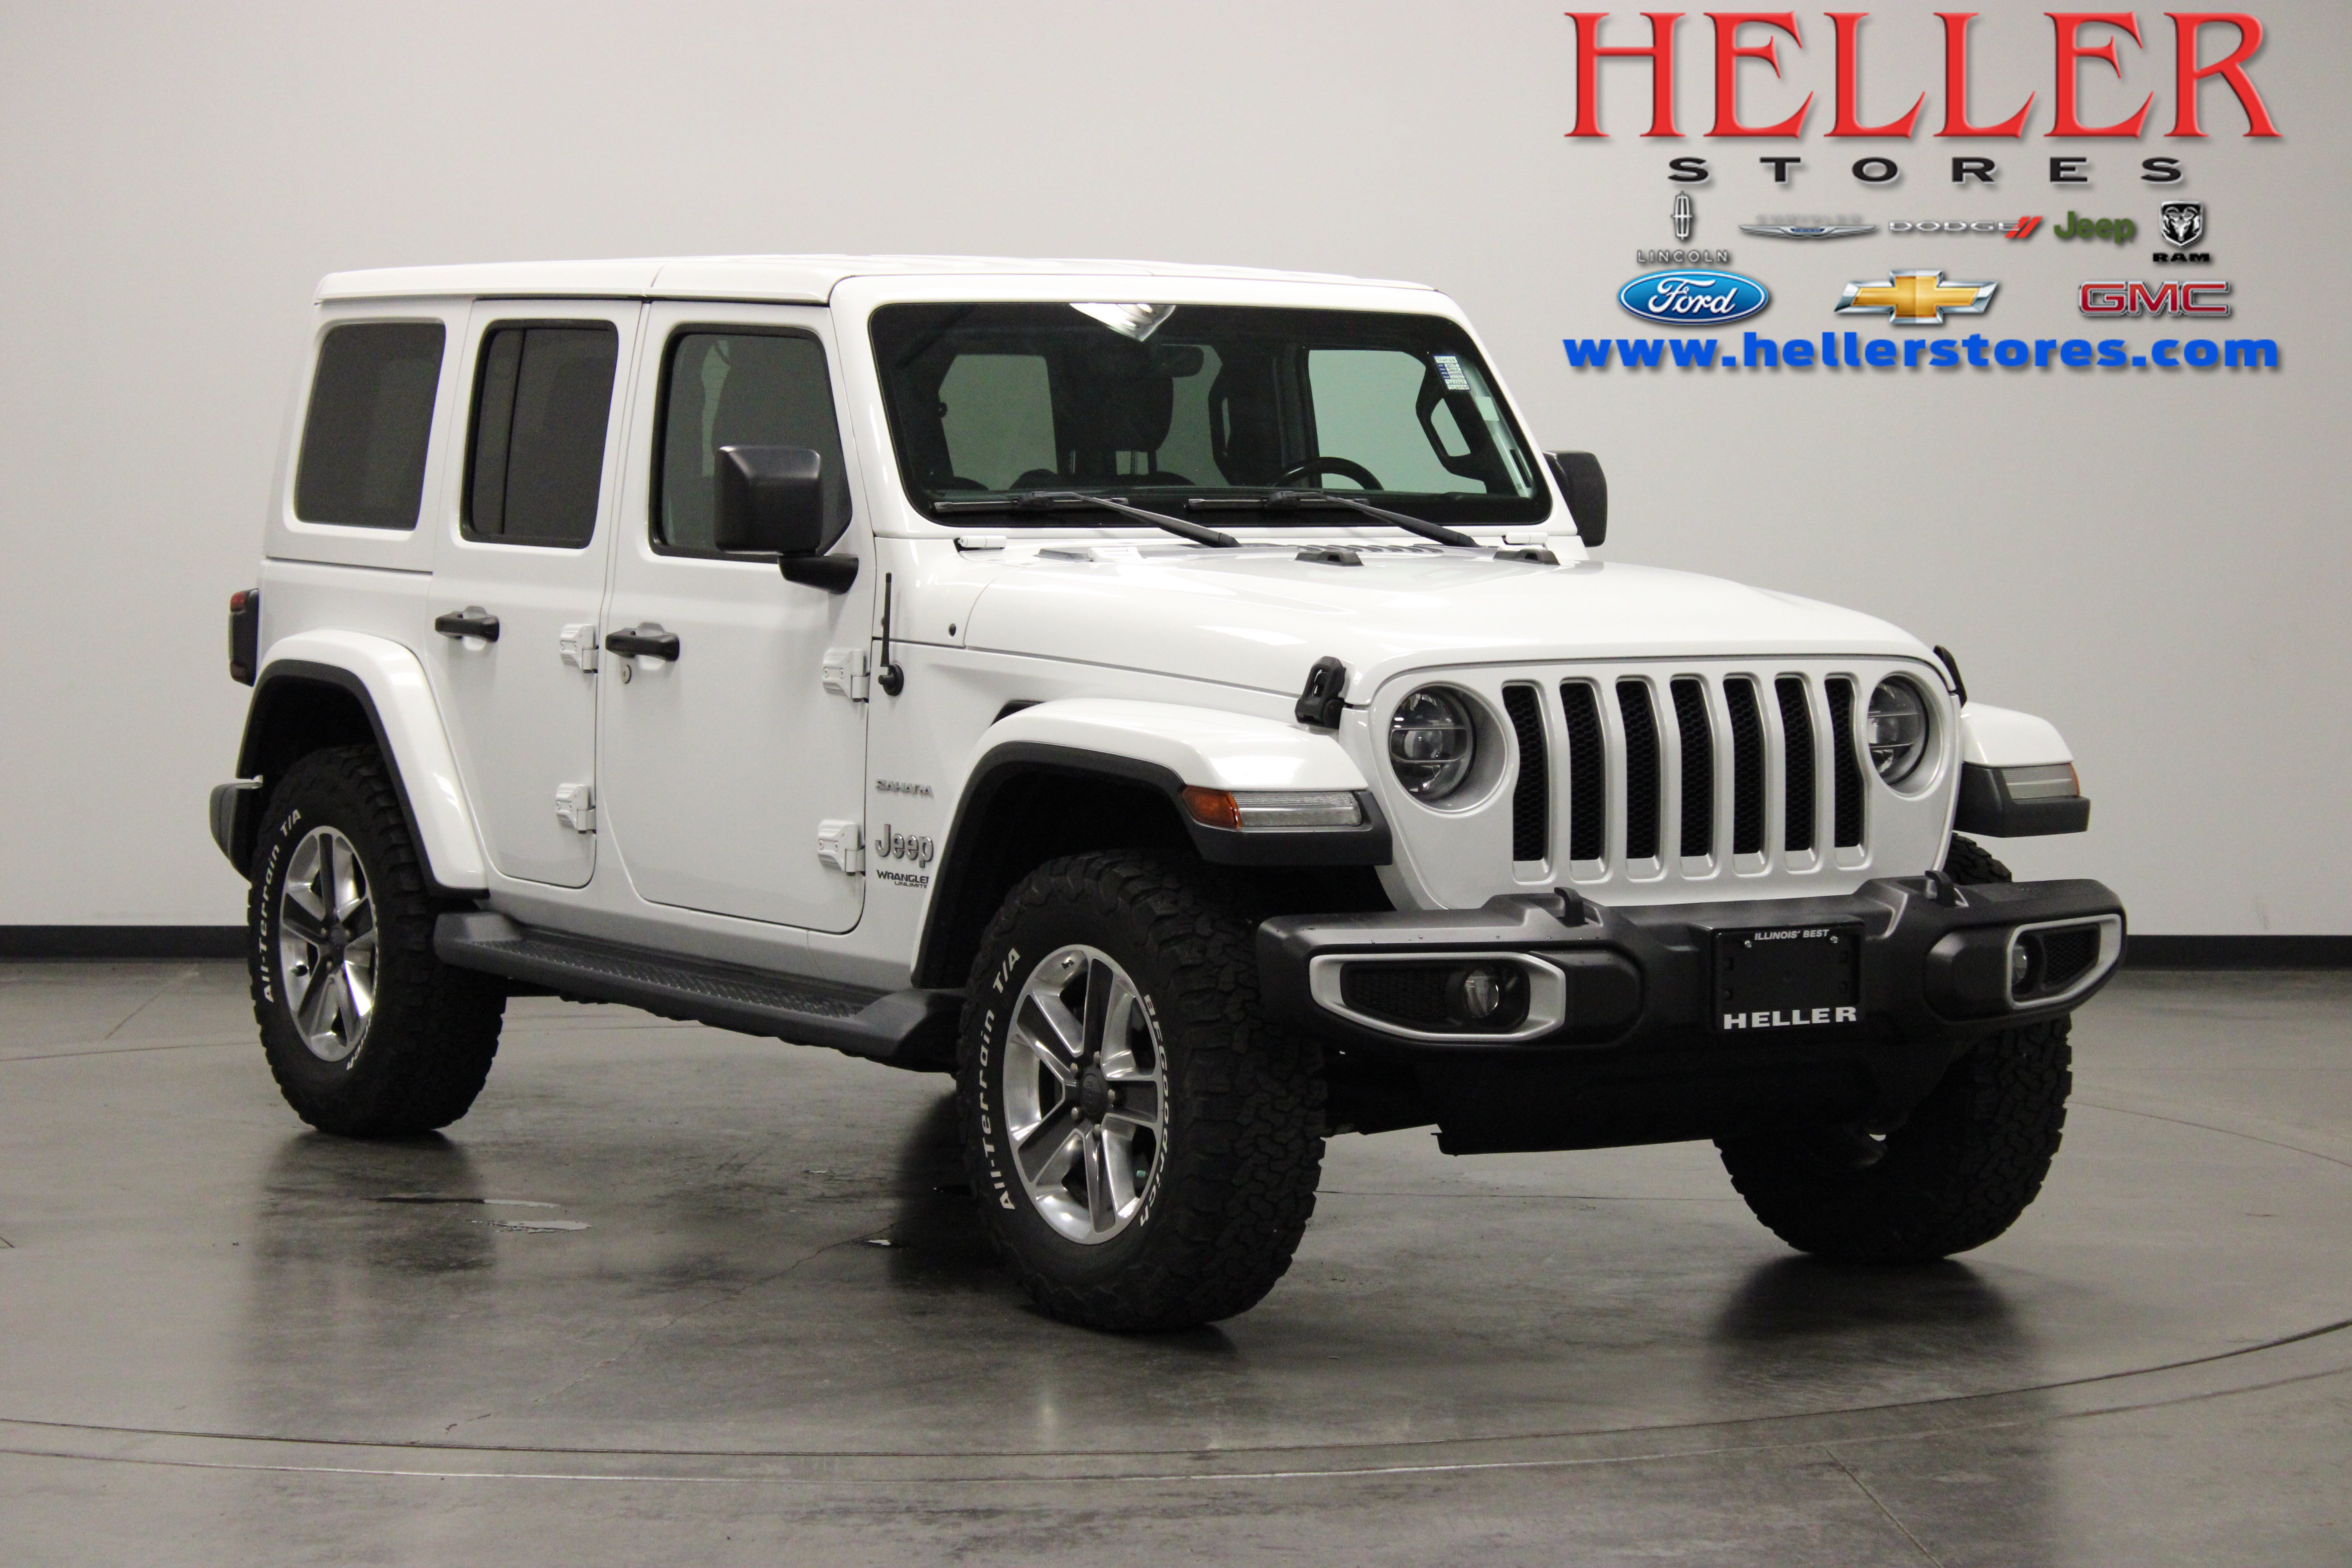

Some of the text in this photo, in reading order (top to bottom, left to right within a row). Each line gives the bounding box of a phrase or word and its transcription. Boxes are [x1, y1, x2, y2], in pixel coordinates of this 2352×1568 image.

[875, 780, 933, 798] SAHARA
[875, 824, 934, 868] Jeep
[257, 809, 301, 1003] All-Terrain T/A
[1754, 929, 1830, 940] ILLINOIS' BEST
[1723, 1007, 1857, 1030] HELLER
[979, 947, 1020, 1210] All-Terrain T/A
